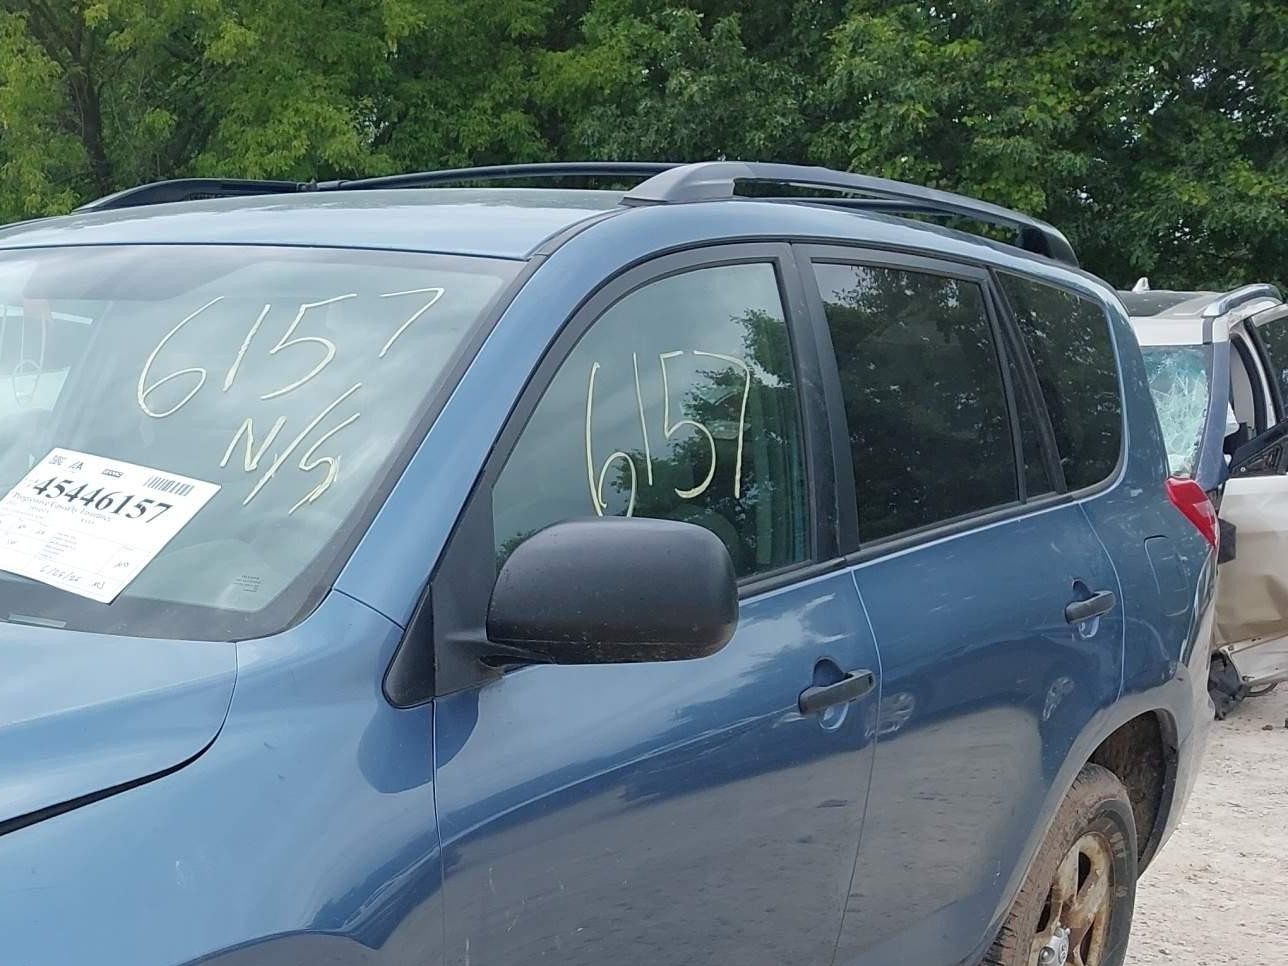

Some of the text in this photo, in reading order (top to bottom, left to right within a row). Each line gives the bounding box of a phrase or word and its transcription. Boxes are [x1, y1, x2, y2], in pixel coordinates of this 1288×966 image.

[137, 286, 445, 419] 6157
[32, 475, 175, 524] 45446157
[219, 382, 363, 517] N/S
[585, 349, 751, 518] 6157
